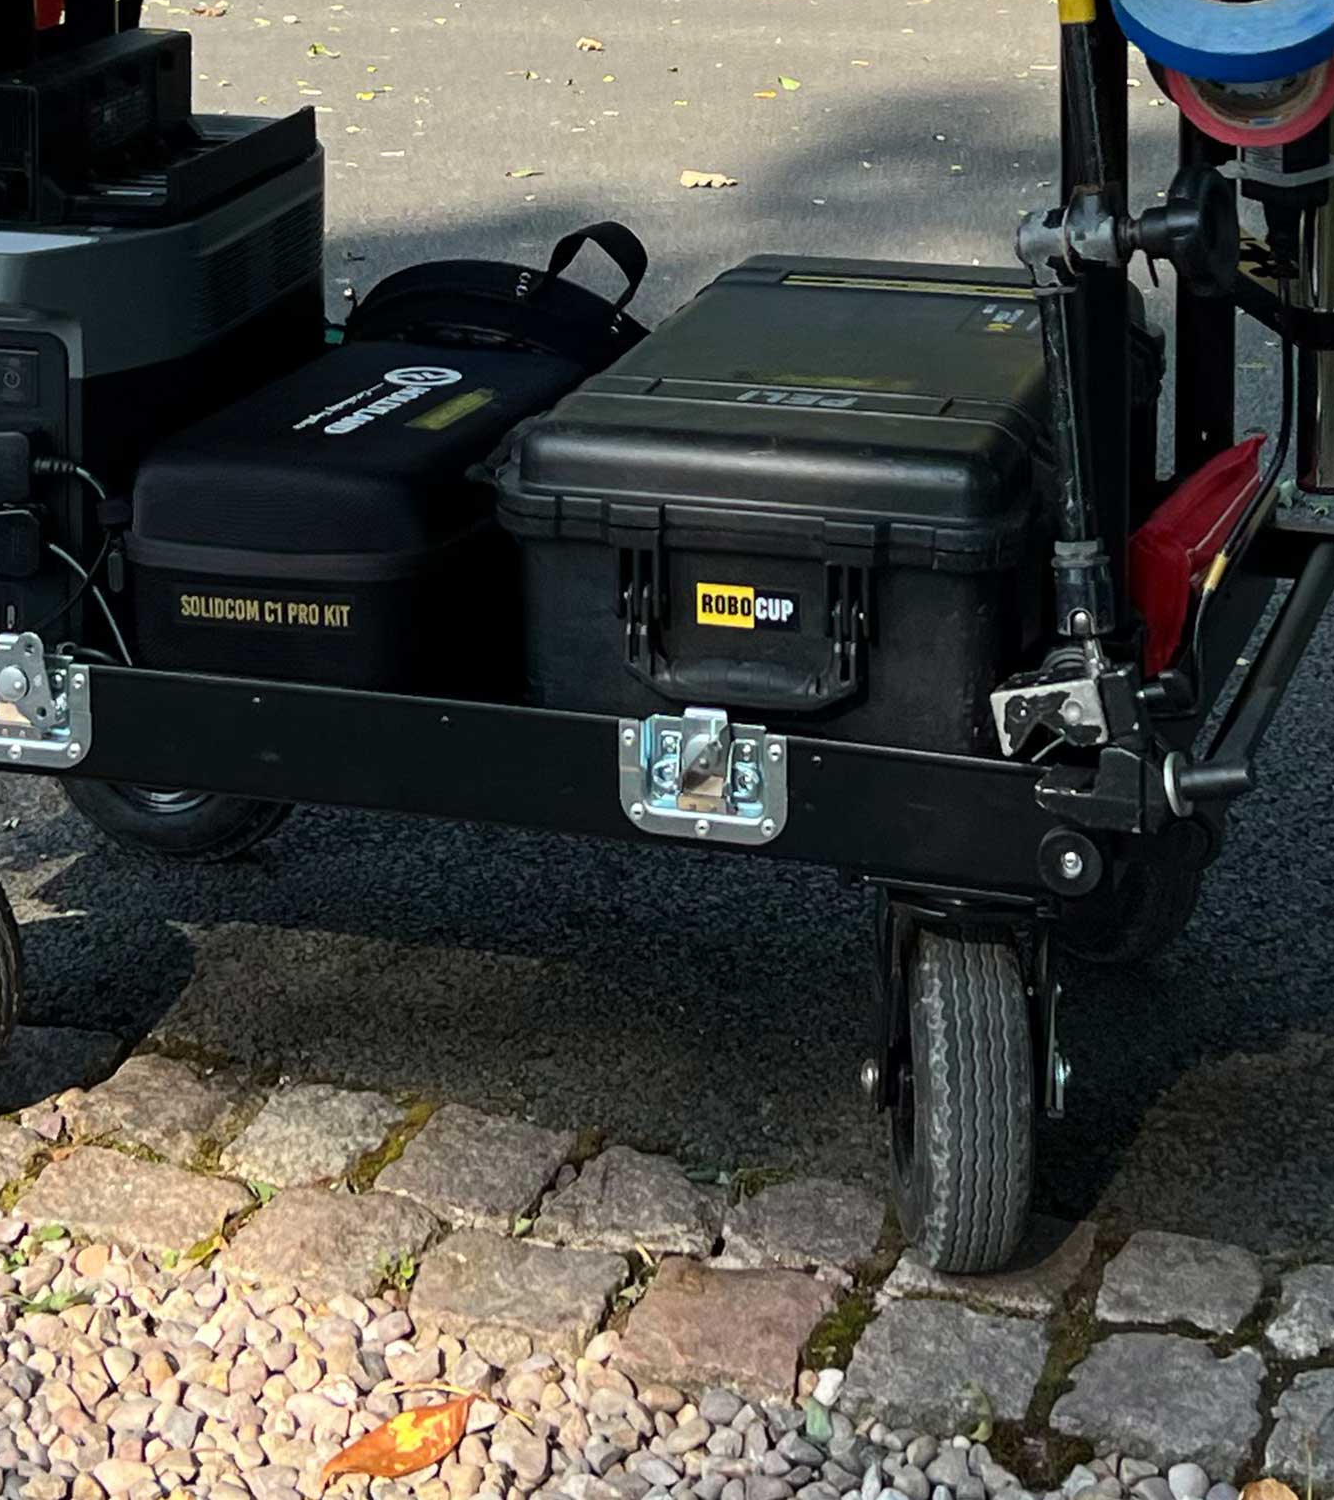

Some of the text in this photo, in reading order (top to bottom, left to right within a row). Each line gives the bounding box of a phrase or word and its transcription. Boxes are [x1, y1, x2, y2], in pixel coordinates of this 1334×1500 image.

[738, 389, 859, 408] PELI
[181, 595, 352, 628] SOLIDCOM C1 PRO KIT
